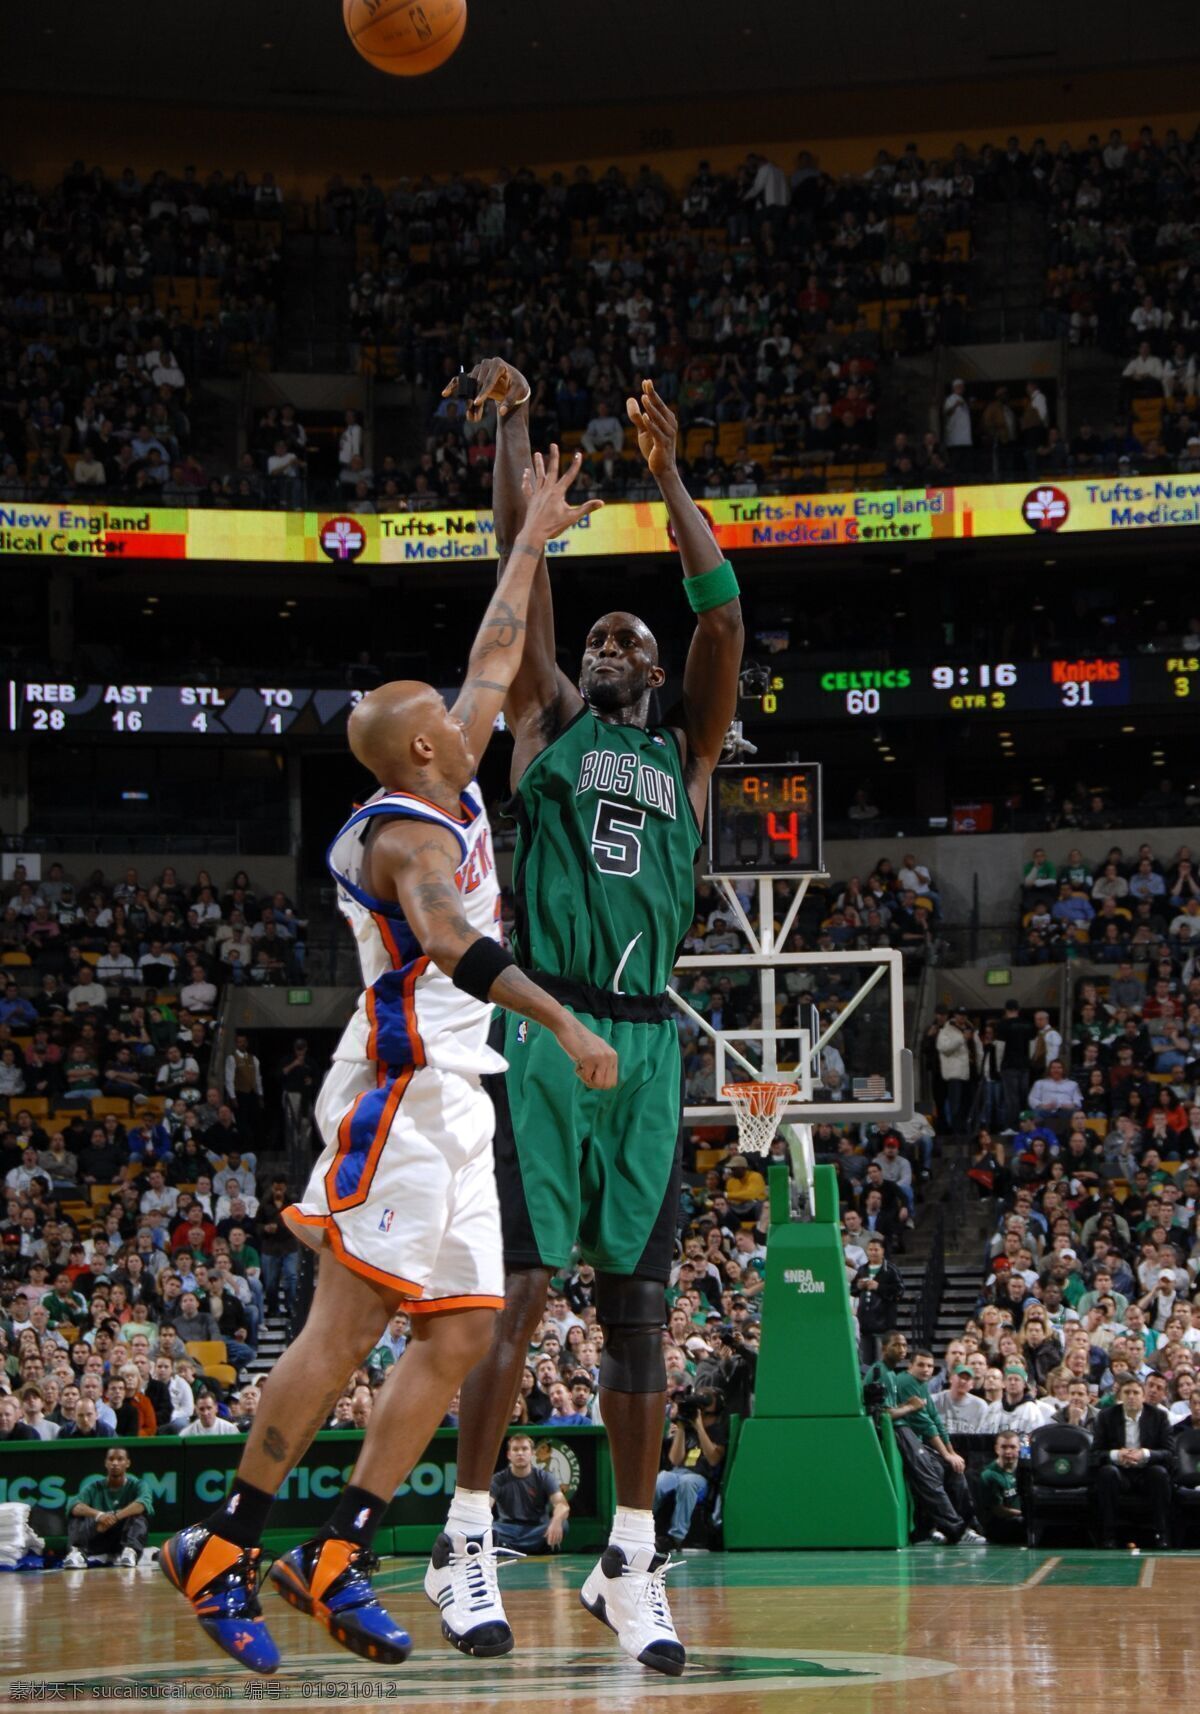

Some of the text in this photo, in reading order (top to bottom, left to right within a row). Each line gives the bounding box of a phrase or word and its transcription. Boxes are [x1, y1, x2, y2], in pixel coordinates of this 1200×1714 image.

[730, 494, 944, 522] Tufts-New England
[1111, 502, 1200, 526] Medical
[0, 508, 150, 535] New England
[752, 520, 922, 545] Medical Center
[51, 533, 126, 553] Center
[404, 538, 489, 560] Medical
[931, 663, 1017, 690] 9:16
[1052, 660, 1120, 683] Knicks
[1167, 658, 1200, 672] FLS
[821, 669, 911, 691] CELTICS
[1174, 676, 1190, 697] 3
[26, 683, 76, 702] REB
[104, 685, 152, 704] AST
[180, 686, 225, 706] STL
[259, 688, 293, 706] TO
[762, 693, 777, 714] 0
[846, 688, 880, 715] 60
[950, 691, 1006, 709] QTR 3
[1061, 680, 1093, 707] 31
[33, 708, 65, 731] 28
[112, 710, 142, 732] 16
[192, 711, 208, 733] 4
[270, 713, 282, 734] 1
[576, 750, 677, 820] BOSON
[742, 775, 808, 803] 9:16
[591, 798, 647, 878] 5
[767, 811, 799, 860] 4
[789, 1269, 814, 1284] NBA
[797, 1281, 825, 1294] .COM
[560, 1444, 581, 1491] CELTICS
